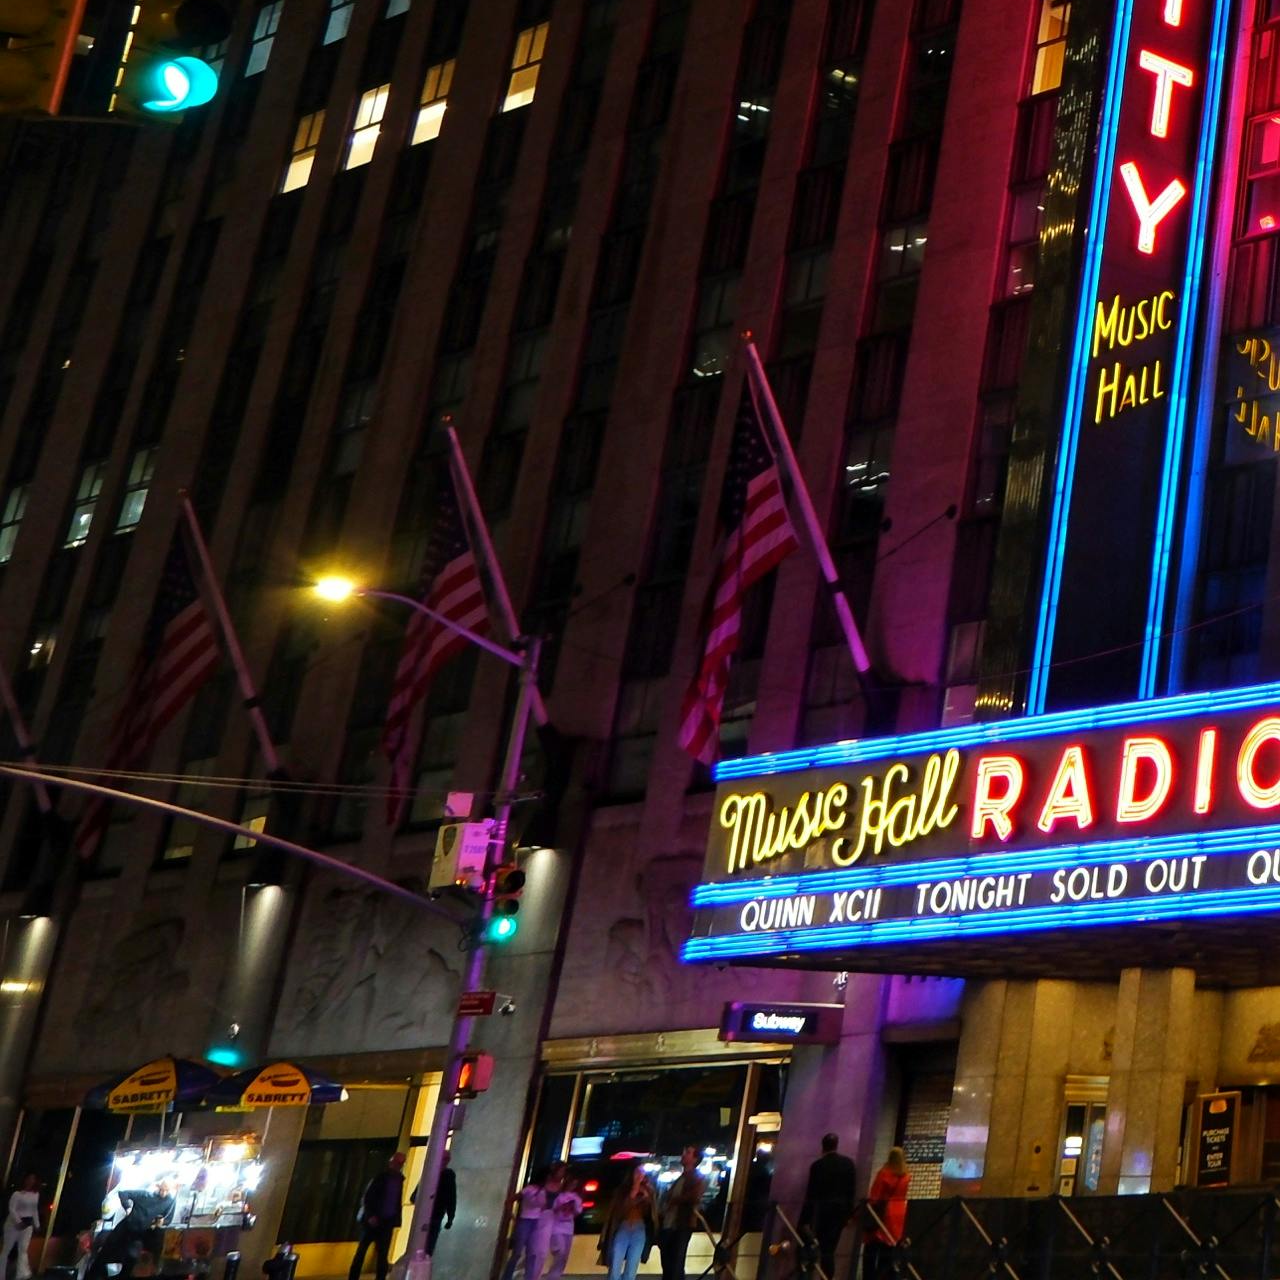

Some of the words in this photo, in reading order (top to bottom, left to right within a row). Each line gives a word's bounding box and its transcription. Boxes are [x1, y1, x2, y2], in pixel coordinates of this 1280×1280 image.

[1093, 291, 1174, 357] MUSIC
[1095, 361, 1164, 424] HALL
[831, 748, 958, 867] Hall
[740, 893, 816, 932] QUINN
[830, 888, 881, 923] XCII
[917, 873, 1032, 915] TONIGHT
[1050, 863, 1128, 903] SOLD
[1145, 855, 1207, 893] OUT
[752, 1012, 806, 1033] Subway
[112, 1088, 173, 1105] SABRETT
[247, 1092, 307, 1103] SABRETT
